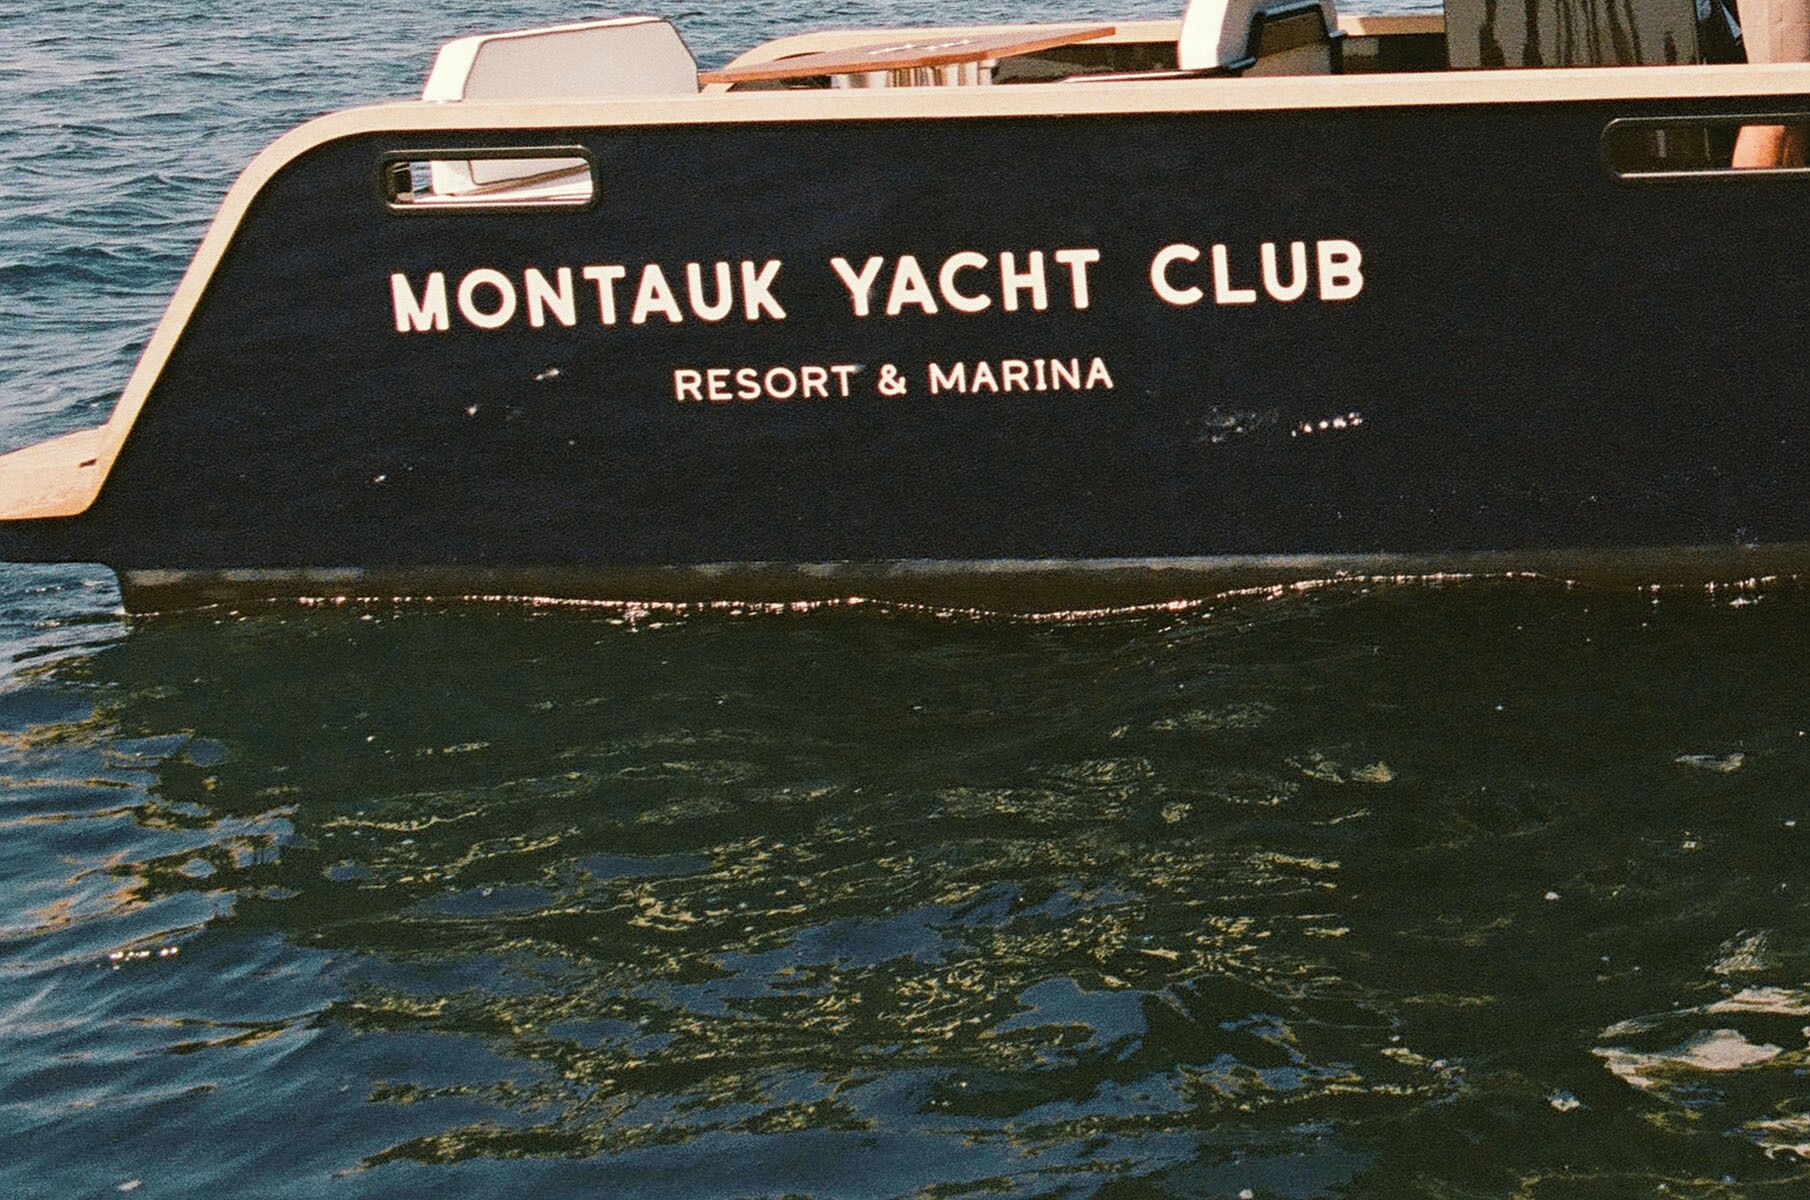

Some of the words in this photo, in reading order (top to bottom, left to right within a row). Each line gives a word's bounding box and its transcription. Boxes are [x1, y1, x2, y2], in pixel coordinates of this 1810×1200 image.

[390, 259, 787, 333] MONTAUK
[829, 248, 1101, 317] YACHT
[1150, 239, 1364, 306] CLUB
[673, 364, 861, 402] RESORT
[877, 363, 908, 396] &
[928, 356, 1114, 395] MARINA
